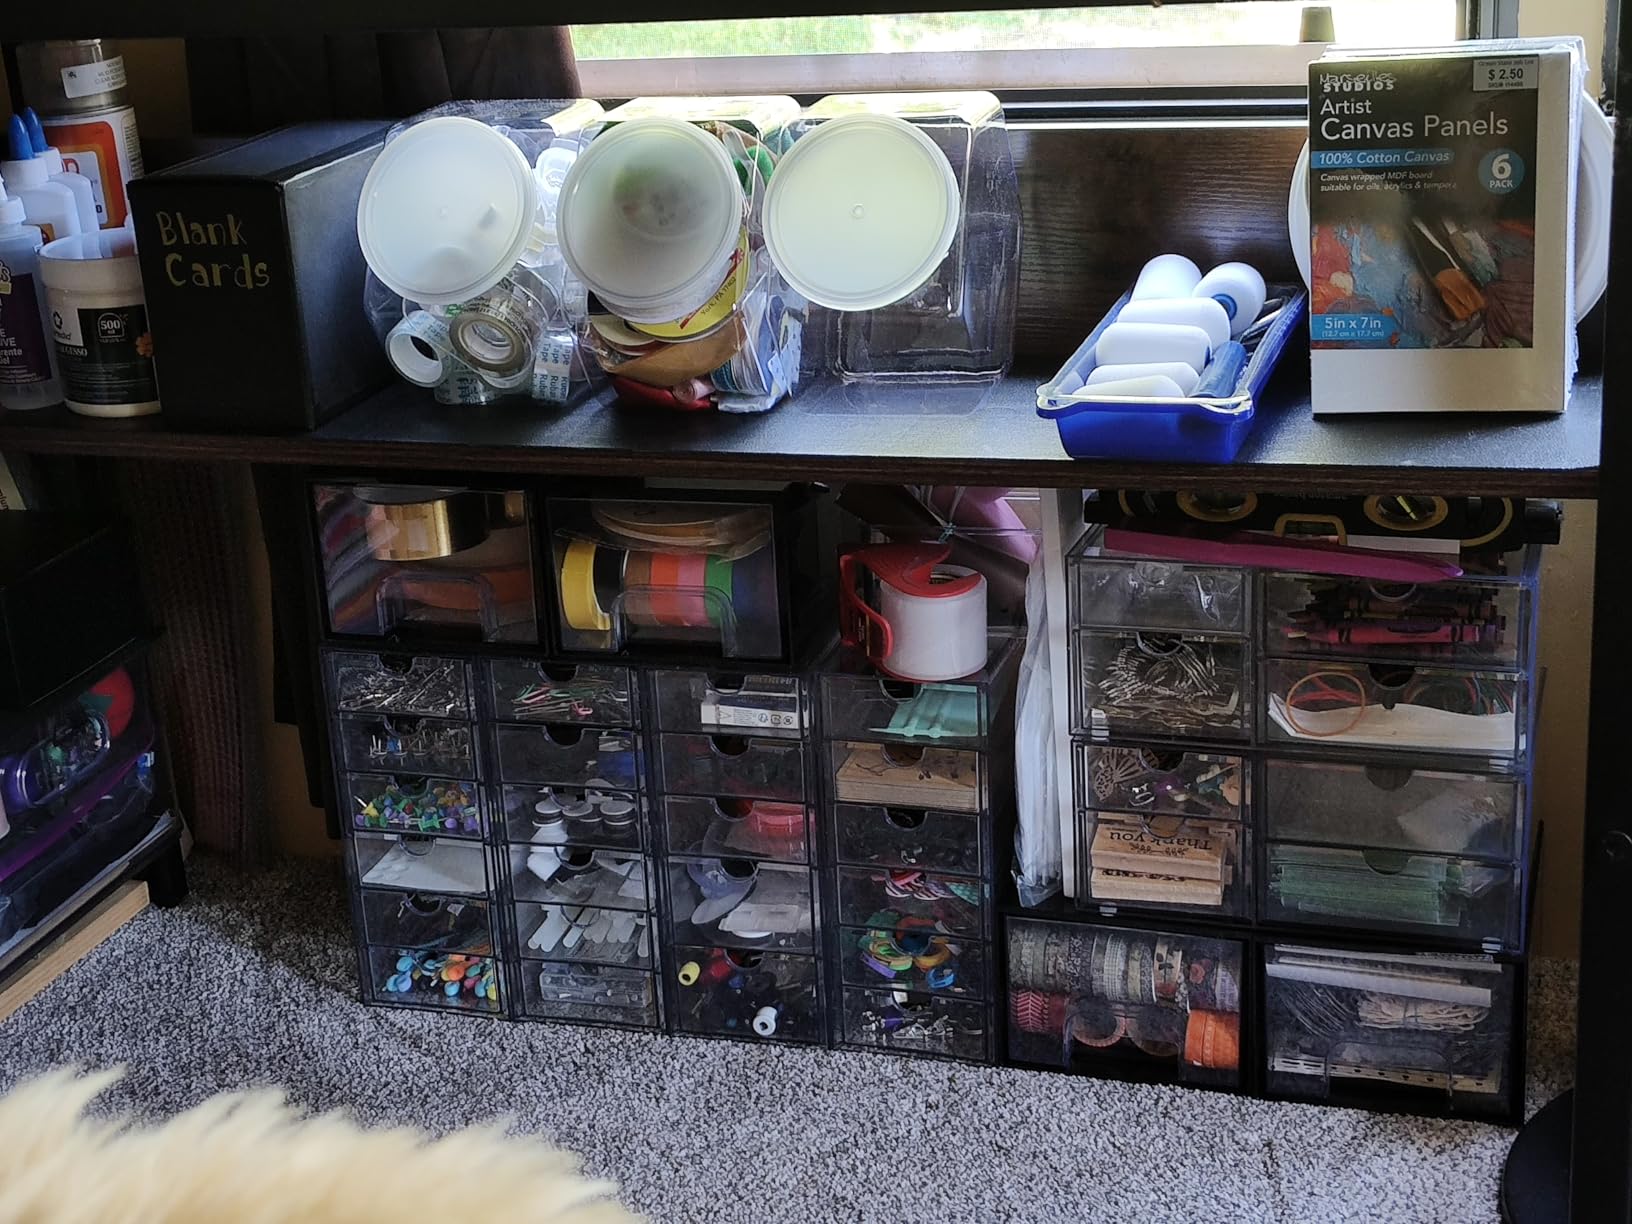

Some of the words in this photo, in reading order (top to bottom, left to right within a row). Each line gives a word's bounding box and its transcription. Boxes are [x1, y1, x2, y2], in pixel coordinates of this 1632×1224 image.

[1488, 69, 1496, 81] $
[1499, 67, 1524, 80] 2.50
[1323, 79, 1395, 93] STUDIOS
[1320, 98, 1372, 115] Artist
[1320, 117, 1414, 140] Canvas
[1424, 111, 1509, 137] Panels
[1319, 152, 1354, 165] 100%
[1356, 151, 1401, 164] Cotton
[1404, 150, 1450, 163] Canvas
[1491, 153, 1512, 180] 6
[1320, 173, 1349, 182] Canvas
[1350, 172, 1386, 183] wrapped
[1387, 171, 1407, 179] MDF
[1408, 171, 1433, 179] board
[1489, 179, 1514, 189] PACK
[1320, 182, 1351, 192] suitable
[1353, 181, 1364, 190] for
[155, 210, 248, 246] Blank
[165, 252, 270, 289] Cards
[100, 319, 121, 331] 500
[541, 342, 551, 362] Tape
[1110, 831, 1144, 842] you
